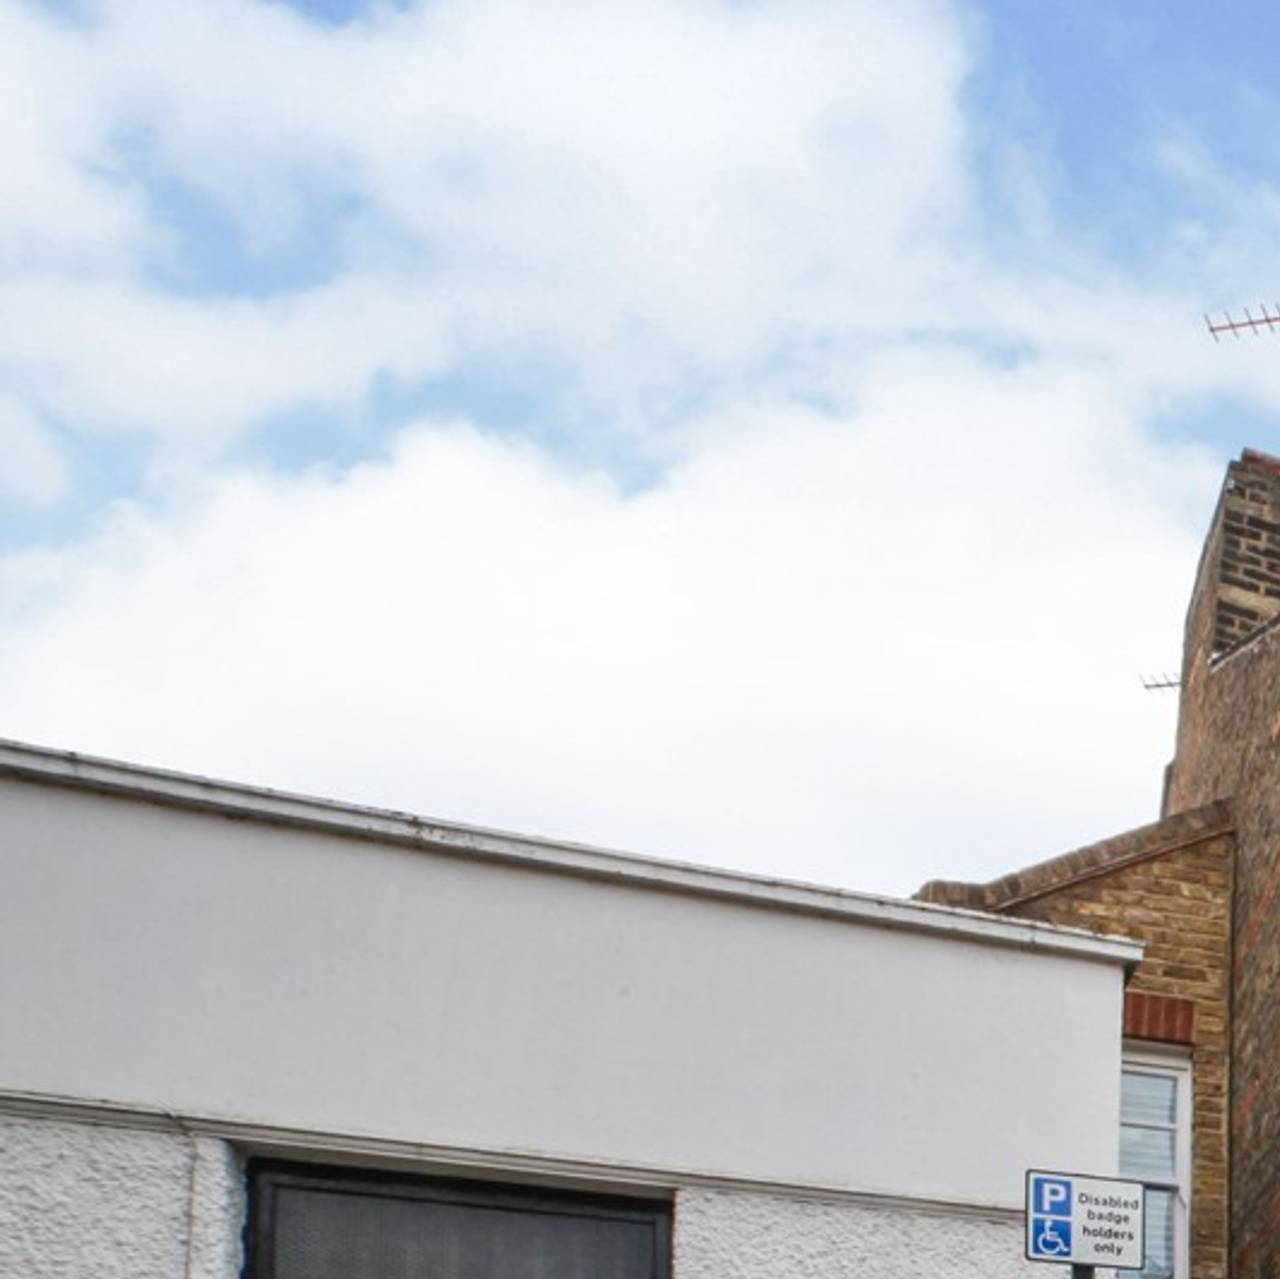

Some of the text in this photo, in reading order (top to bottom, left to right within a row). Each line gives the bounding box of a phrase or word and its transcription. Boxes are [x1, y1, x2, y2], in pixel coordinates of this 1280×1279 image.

[1042, 1183, 1067, 1211] P
[1078, 1192, 1139, 1210] Disabled
[1087, 1210, 1130, 1224] badge
[1082, 1226, 1134, 1241] holders
[1093, 1241, 1124, 1255] only
